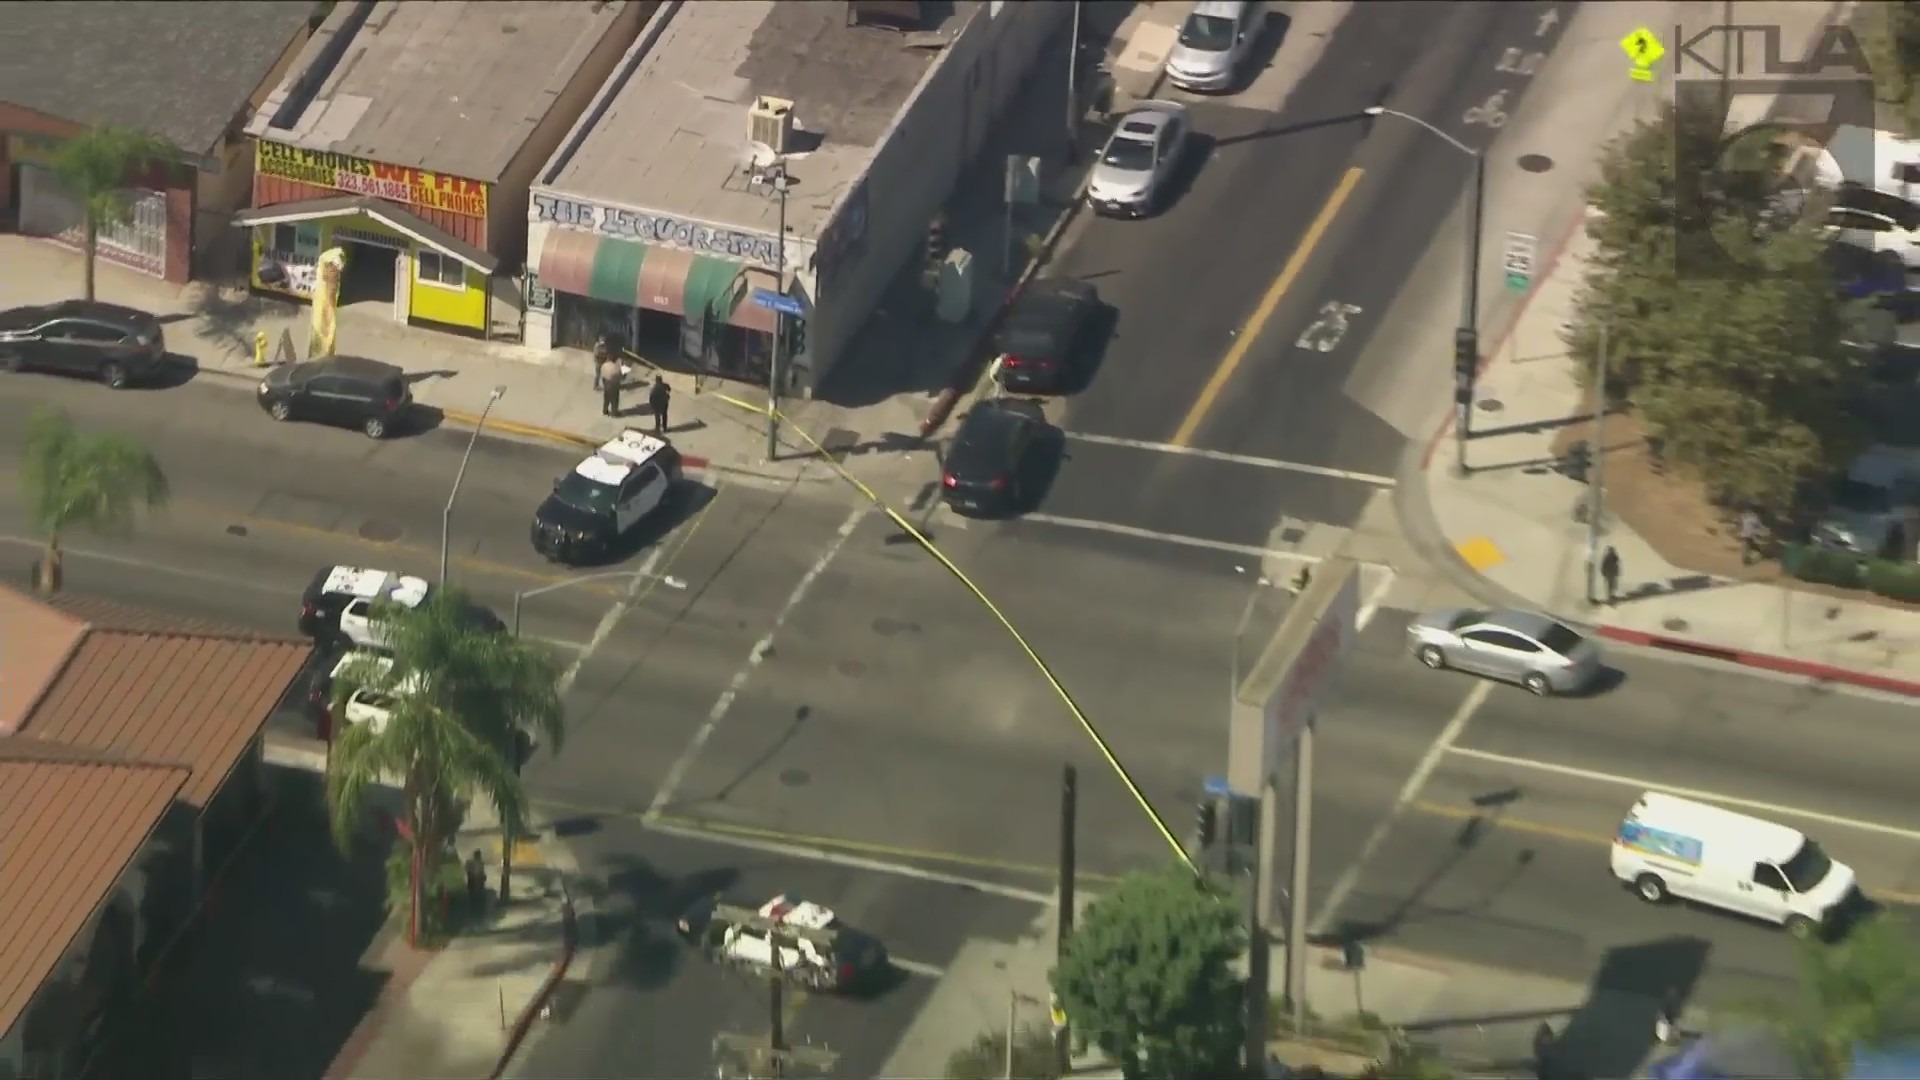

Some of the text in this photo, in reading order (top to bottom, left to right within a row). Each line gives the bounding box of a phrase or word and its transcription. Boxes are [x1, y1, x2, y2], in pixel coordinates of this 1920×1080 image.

[259, 138, 371, 176] CELL PHONES
[259, 157, 336, 187] ACCESSORIES
[410, 184, 486, 217] CELL PHONES
[533, 193, 788, 267] THE LIQUOR STORE
